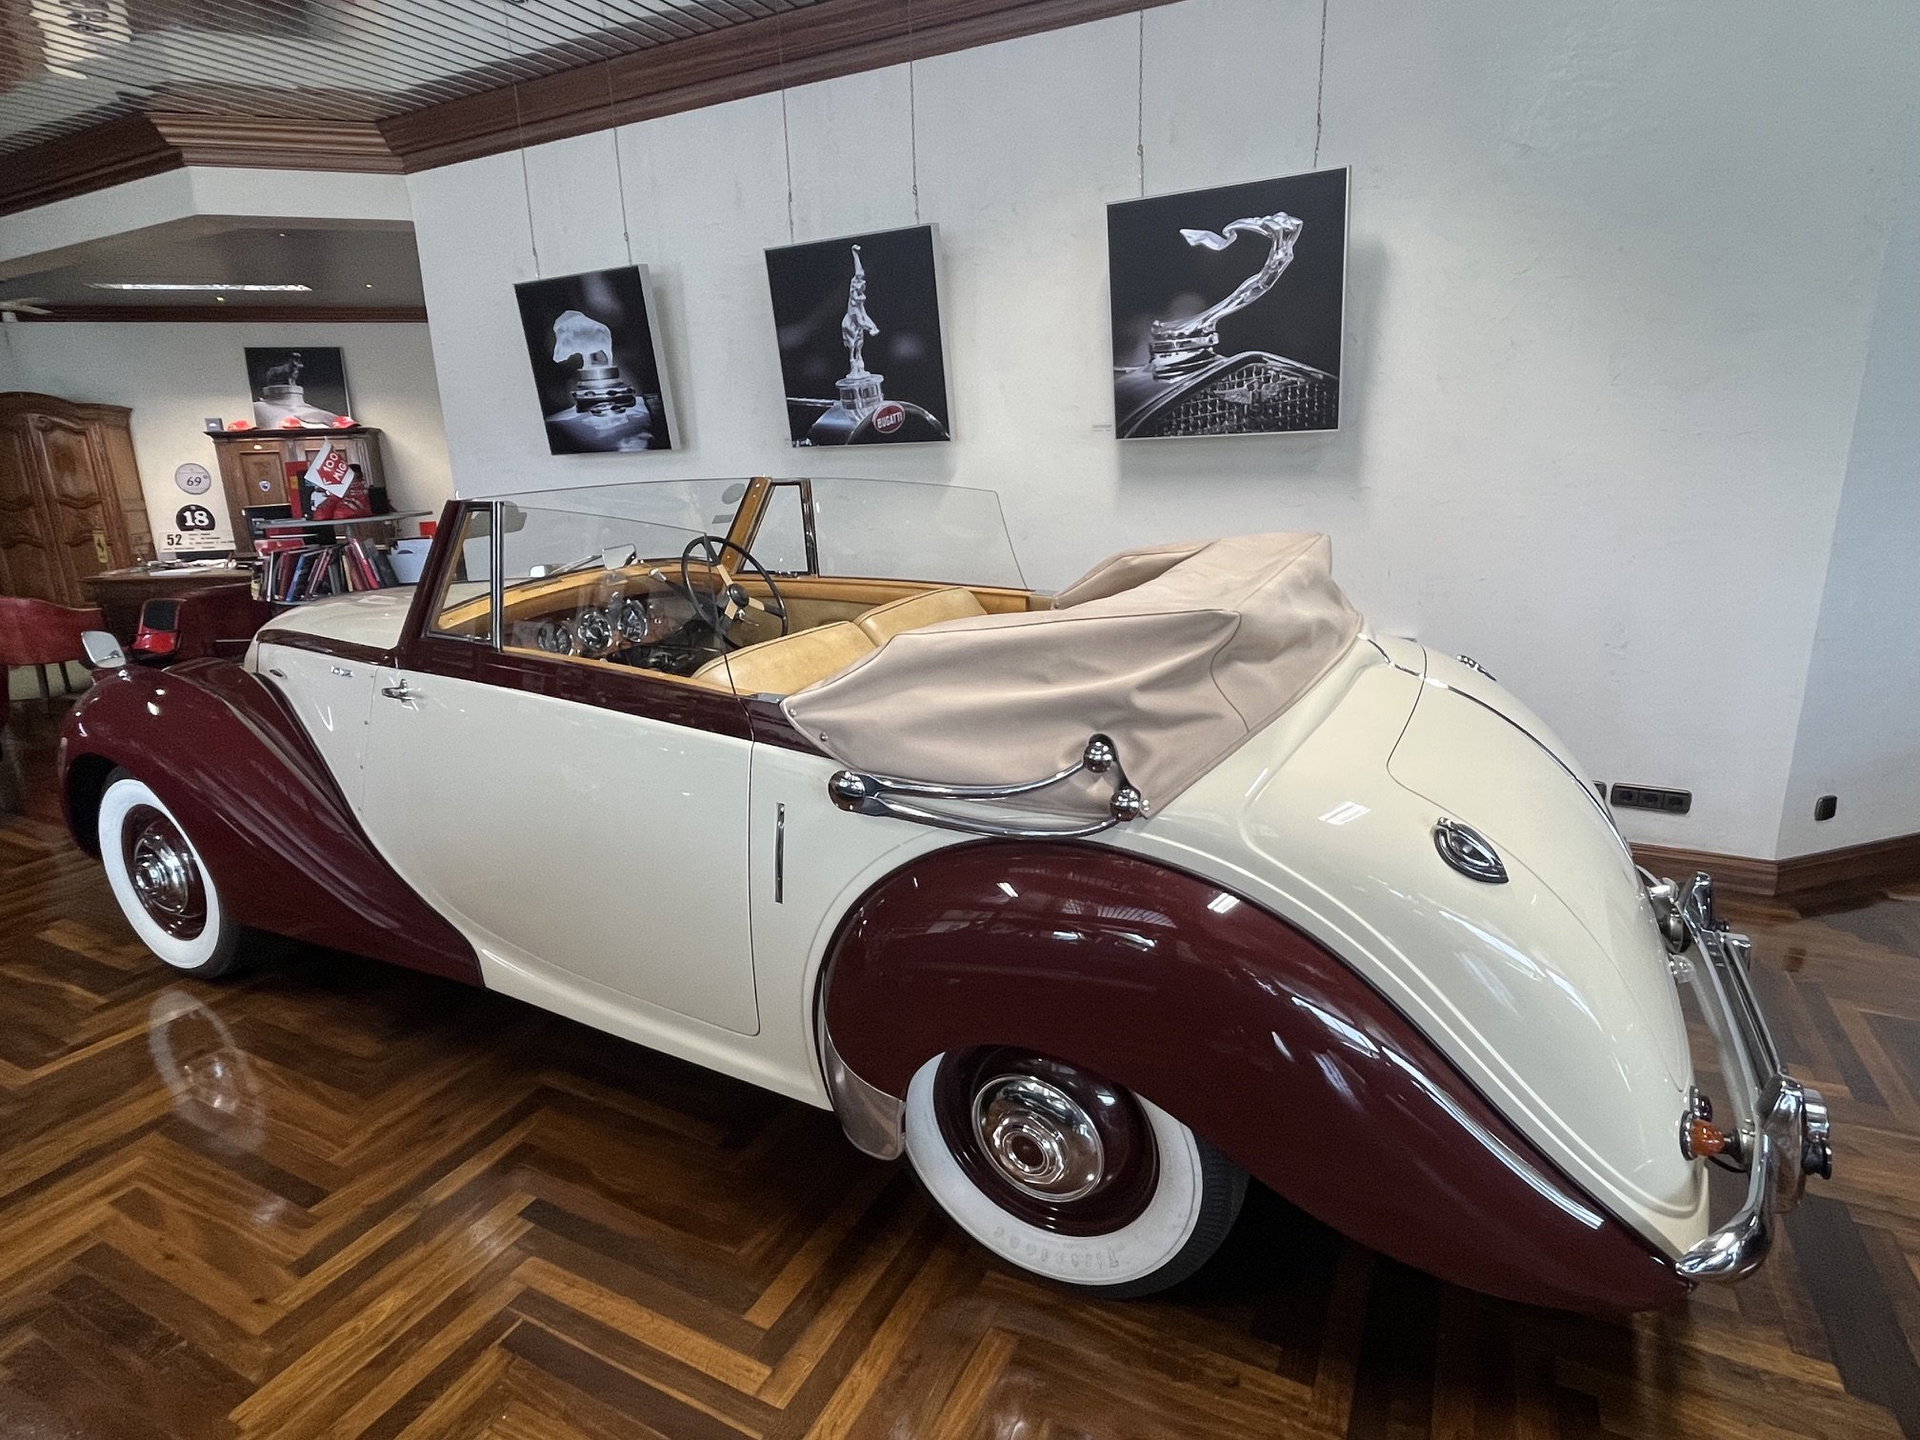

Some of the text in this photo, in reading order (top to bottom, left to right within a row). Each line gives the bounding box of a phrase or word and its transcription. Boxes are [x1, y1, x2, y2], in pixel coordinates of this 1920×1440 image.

[333, 460, 347, 481] MIG
[186, 476, 202, 487] 69
[183, 511, 210, 526] 18
[166, 533, 182, 546] 52
